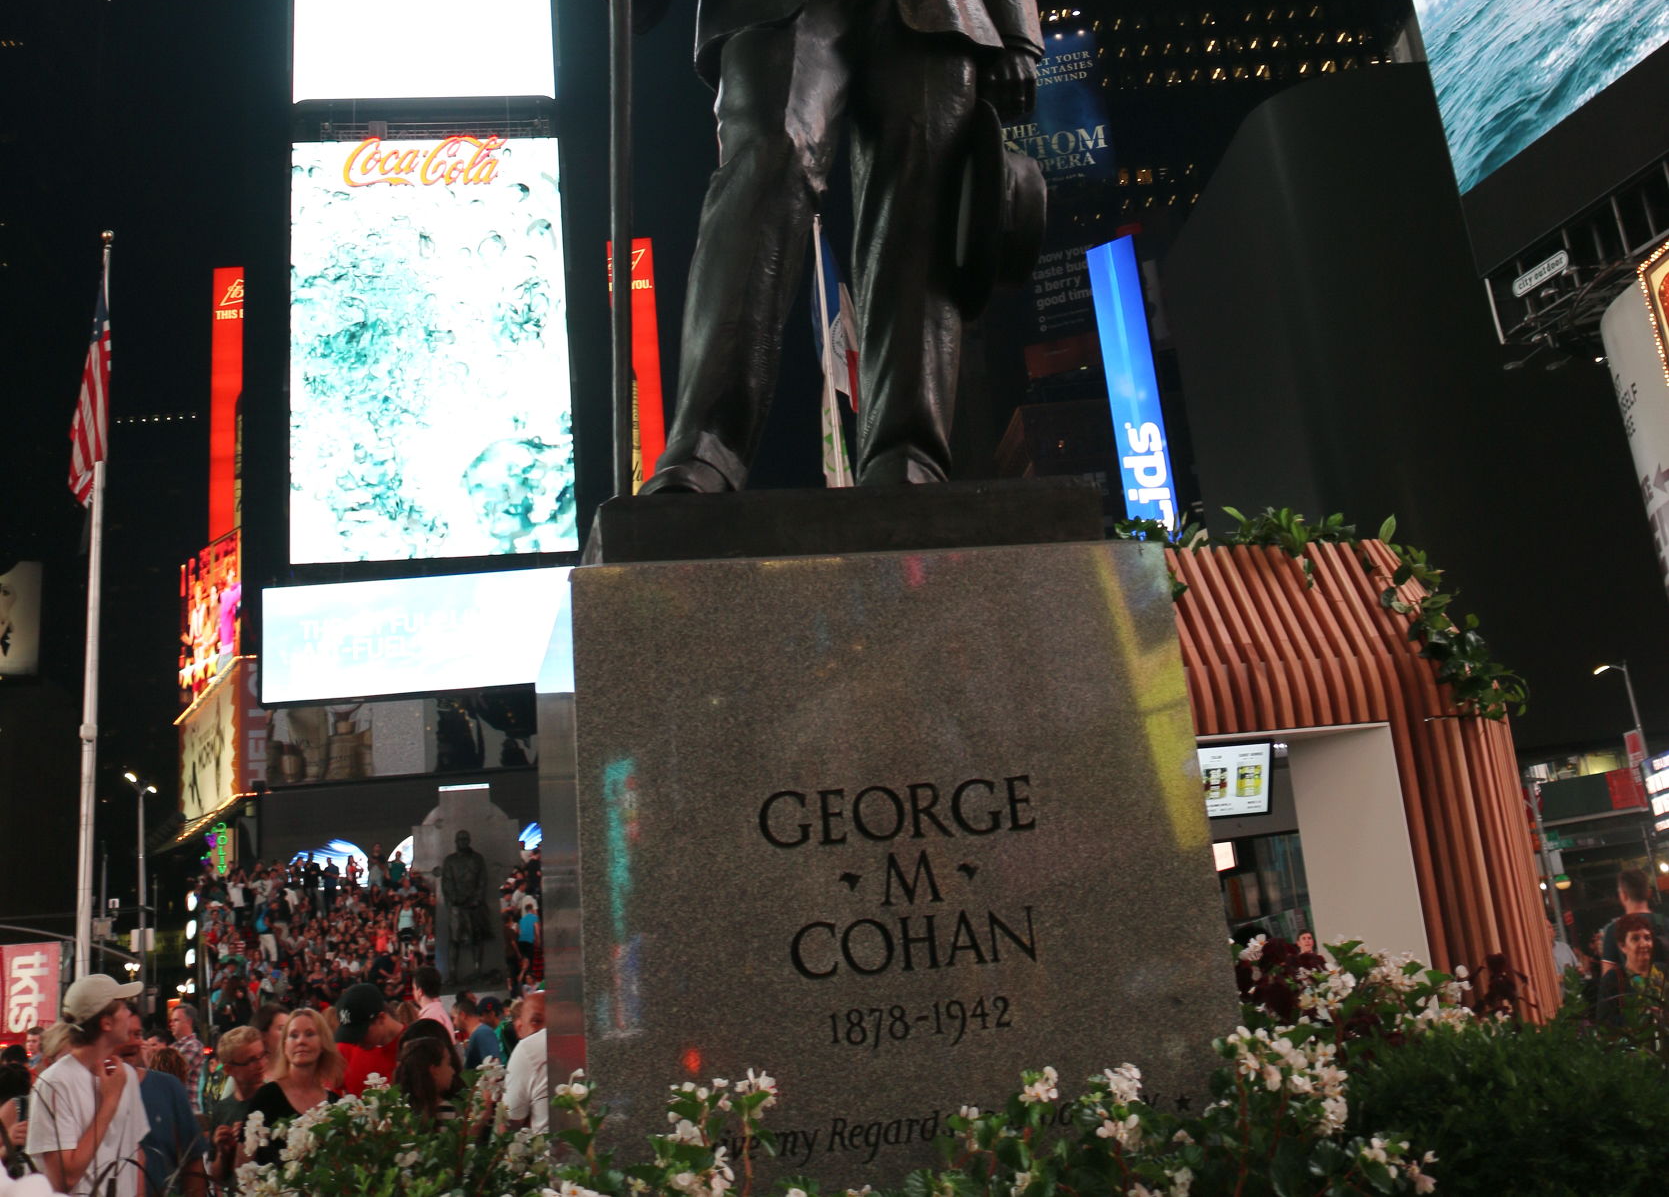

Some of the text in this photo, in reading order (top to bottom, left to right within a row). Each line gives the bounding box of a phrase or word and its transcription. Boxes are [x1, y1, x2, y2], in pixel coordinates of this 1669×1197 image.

[1035, 59, 1094, 77] ANTASIES
[1055, 50, 1091, 63] YOUR
[1035, 71, 1088, 87] UNWIND
[1001, 123, 1040, 141] THE
[1004, 124, 1109, 159] NTOM
[343, 135, 507, 187] Coca-Cola
[1068, 288, 1093, 301] tim
[215, 309, 238, 320] THIS
[758, 774, 1037, 849] GEORGE
[880, 849, 943, 906] M
[789, 905, 1039, 981] COHAN
[8, 951, 49, 1034] tkts
[828, 995, 1013, 1049] 1878-1942
[713, 1129, 761, 1160] ive
[774, 1128, 819, 1168] my
